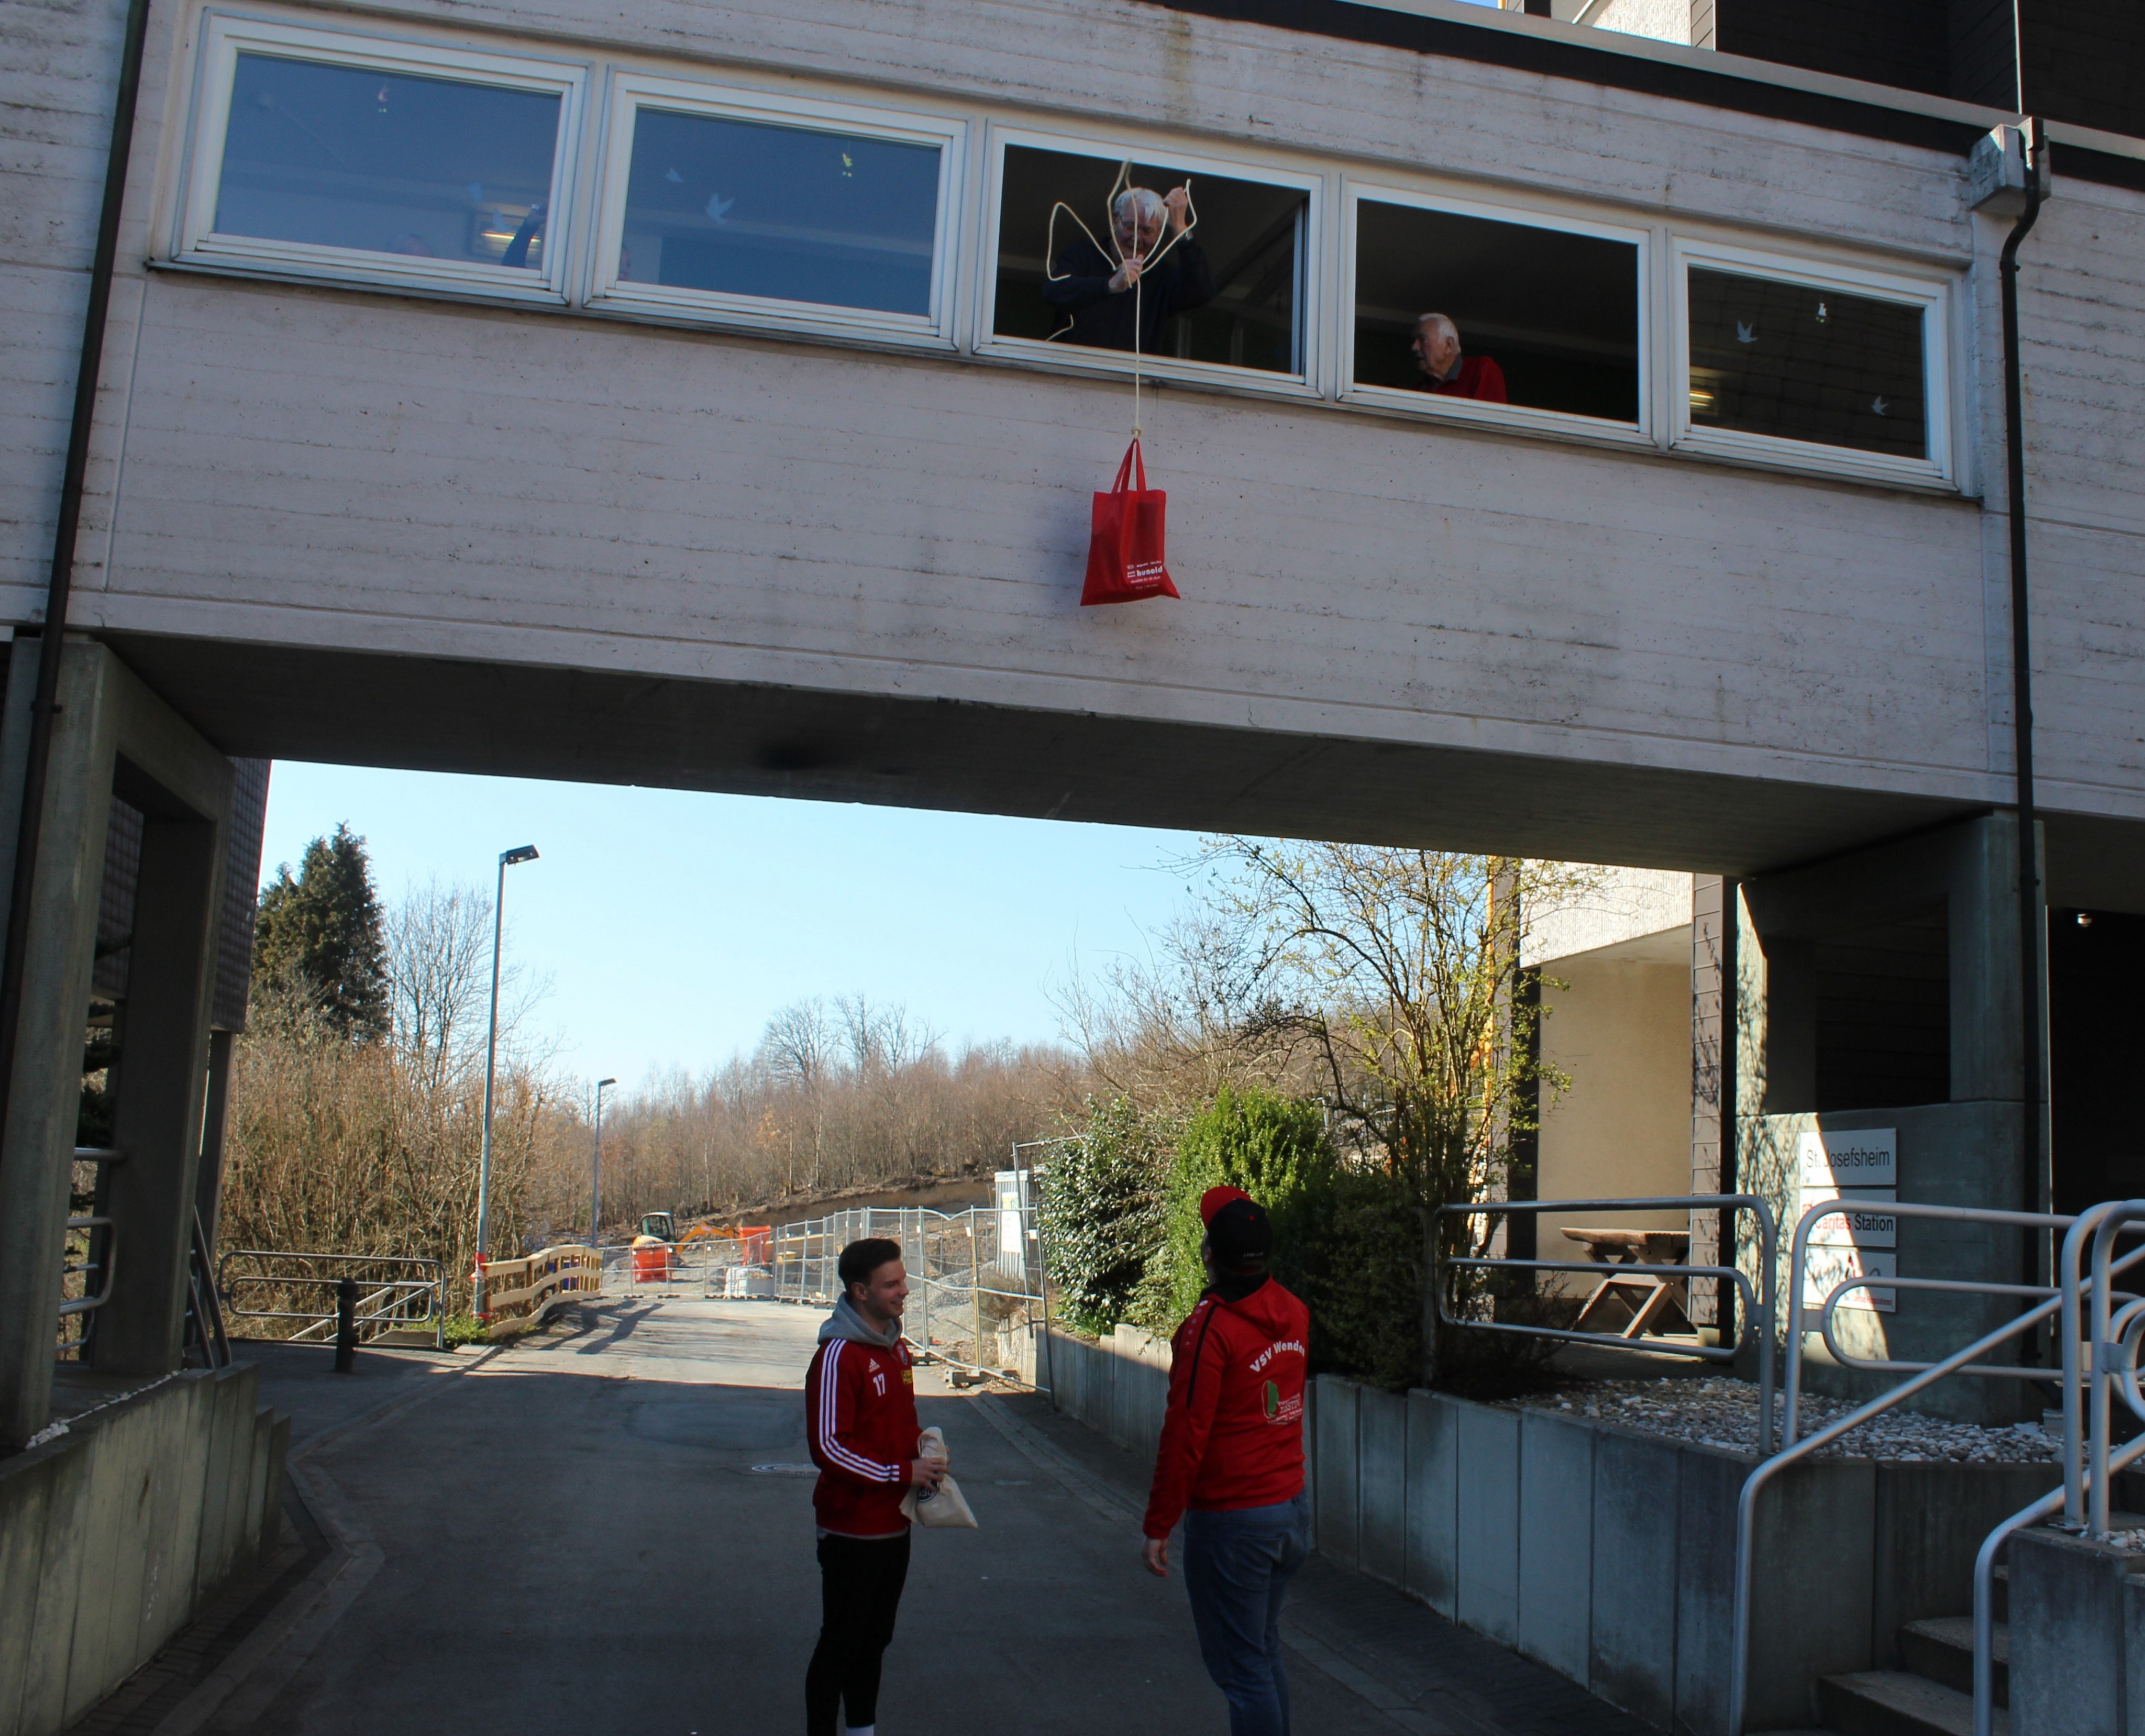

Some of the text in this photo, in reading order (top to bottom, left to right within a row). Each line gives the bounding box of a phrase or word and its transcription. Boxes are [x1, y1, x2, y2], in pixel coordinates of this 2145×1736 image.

[1137, 566, 1163, 576] hunold
[1806, 1147, 1889, 1168] St. Josefsheim
[1854, 1213, 1893, 1231] Station
[1250, 1347, 1271, 1372] VSV
[872, 1373, 886, 1397] 17
